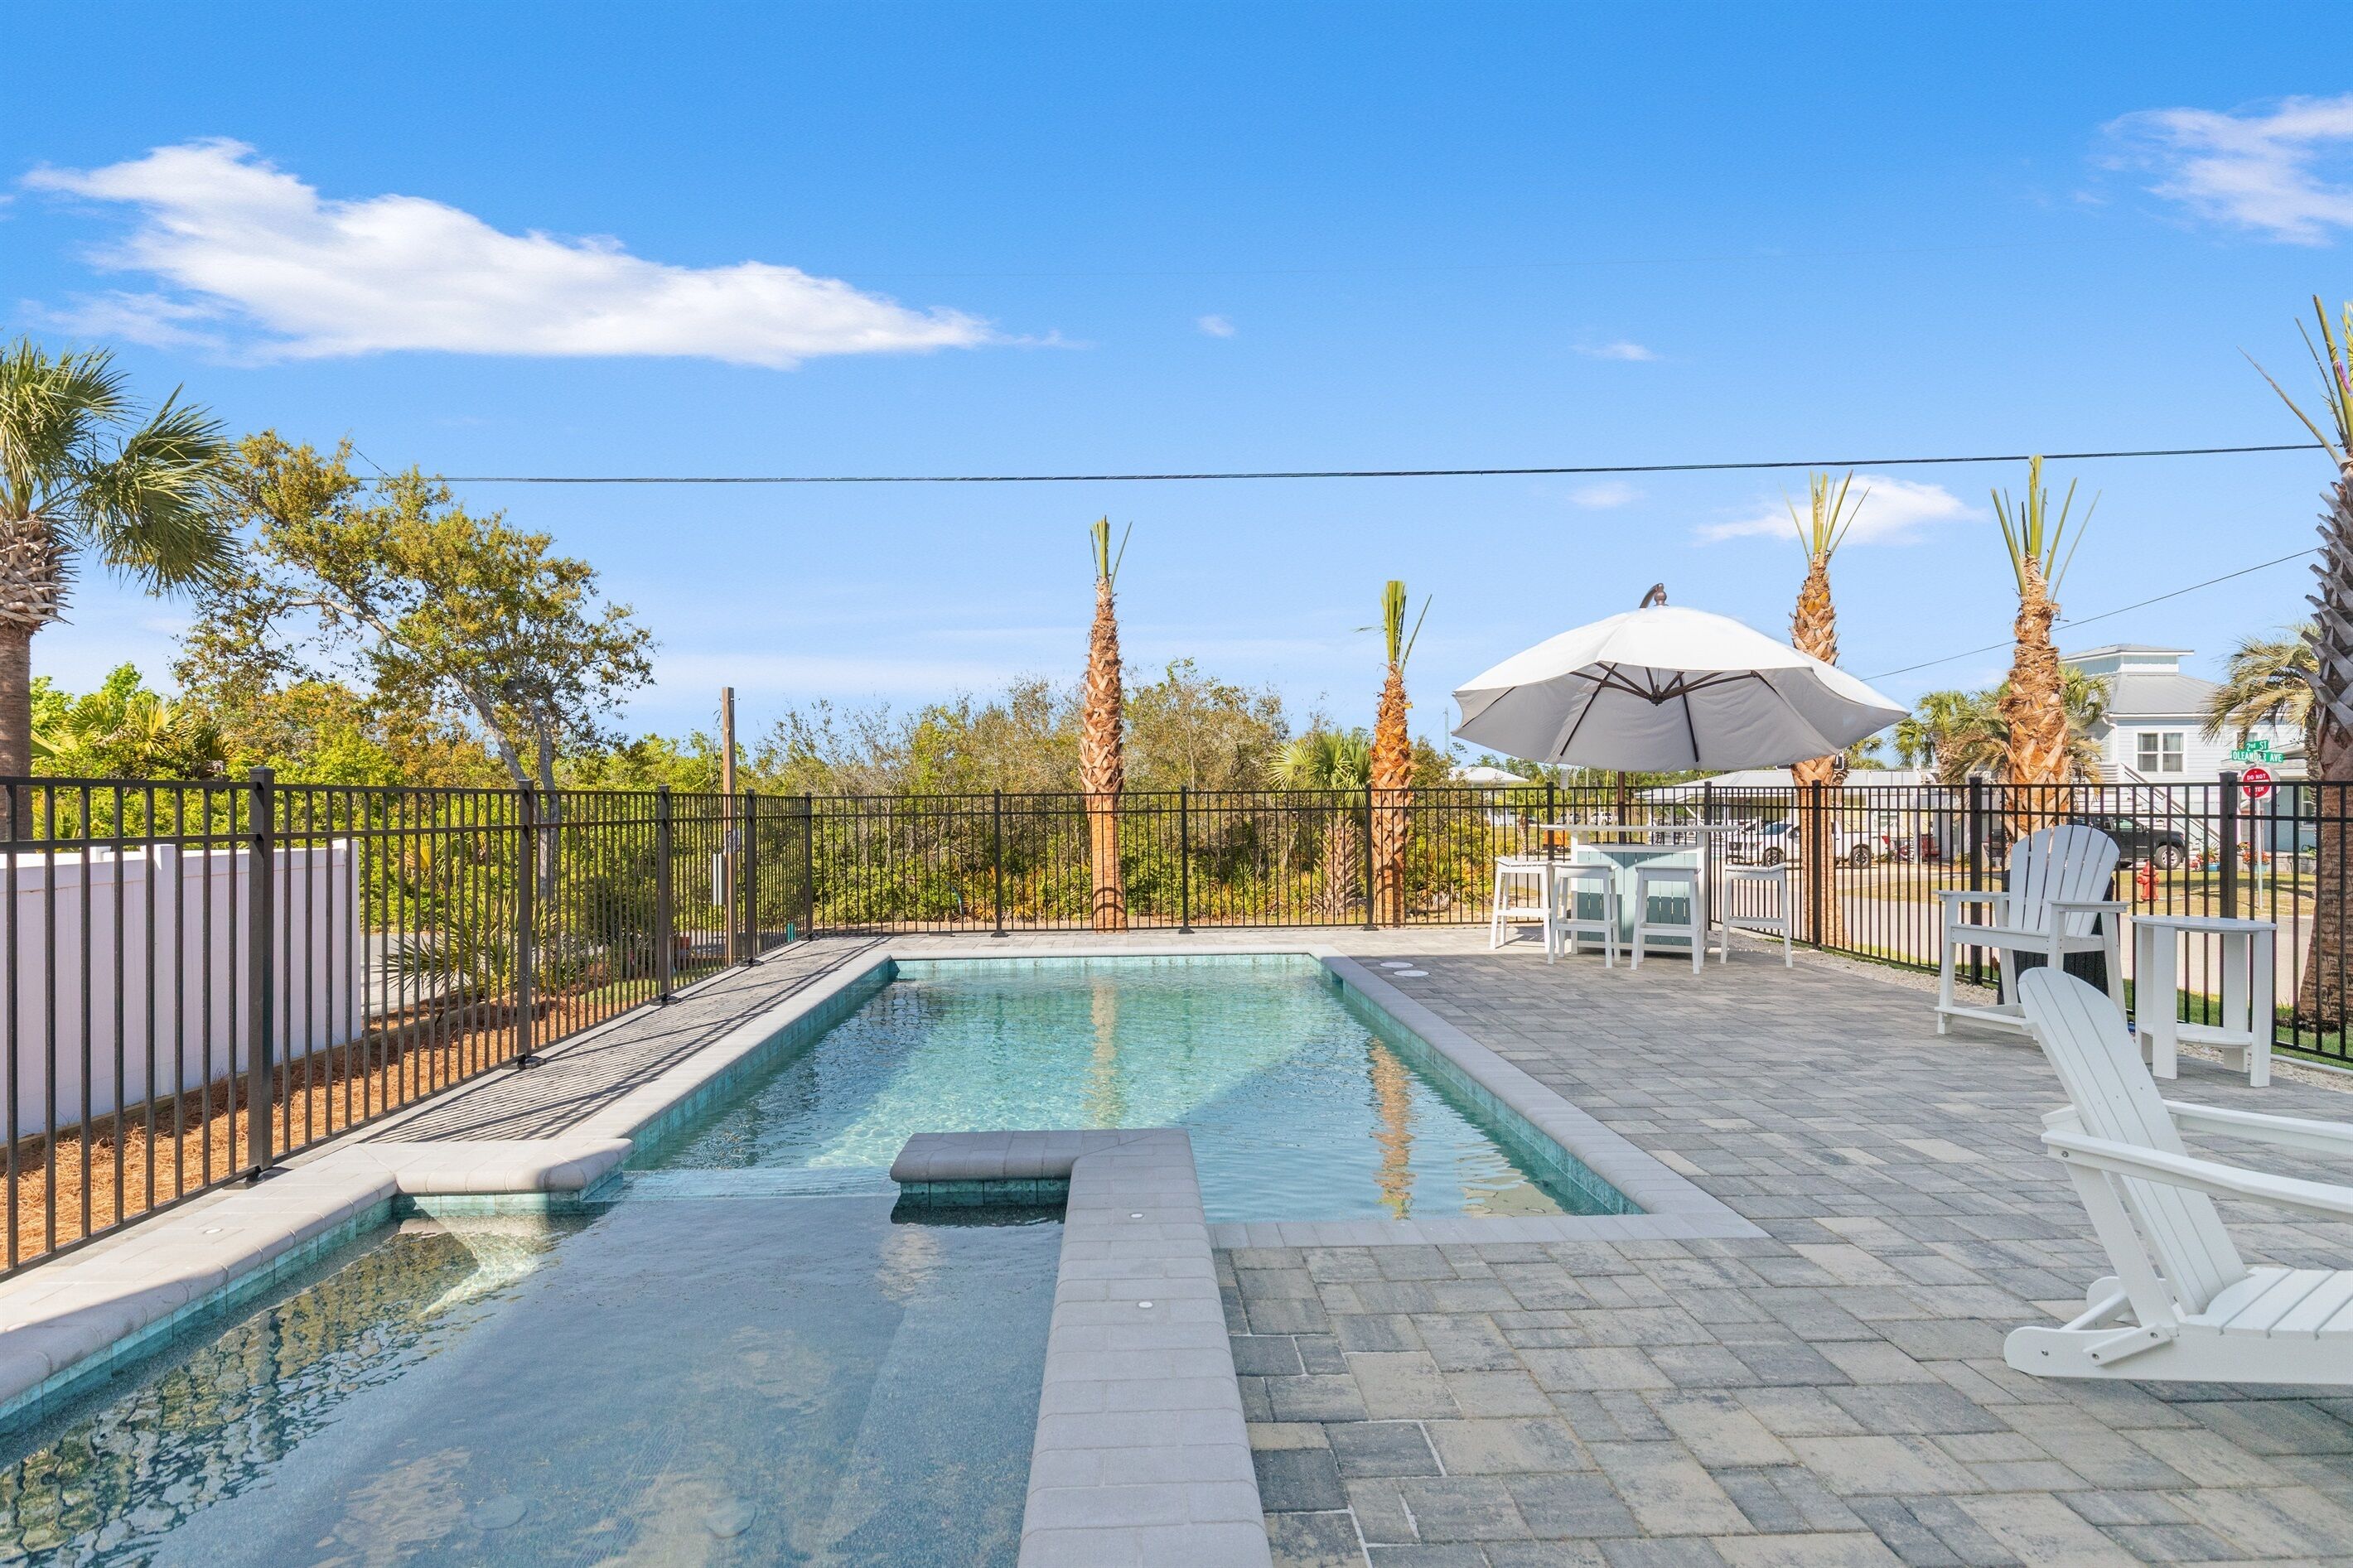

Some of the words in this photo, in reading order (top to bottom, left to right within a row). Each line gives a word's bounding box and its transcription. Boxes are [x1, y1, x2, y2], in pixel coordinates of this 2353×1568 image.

[2246, 743, 2256, 751] 2nd
[2259, 741, 2268, 750] ST
[2233, 751, 2267, 761] OLEANDER
[2269, 754, 2283, 762] AVE
